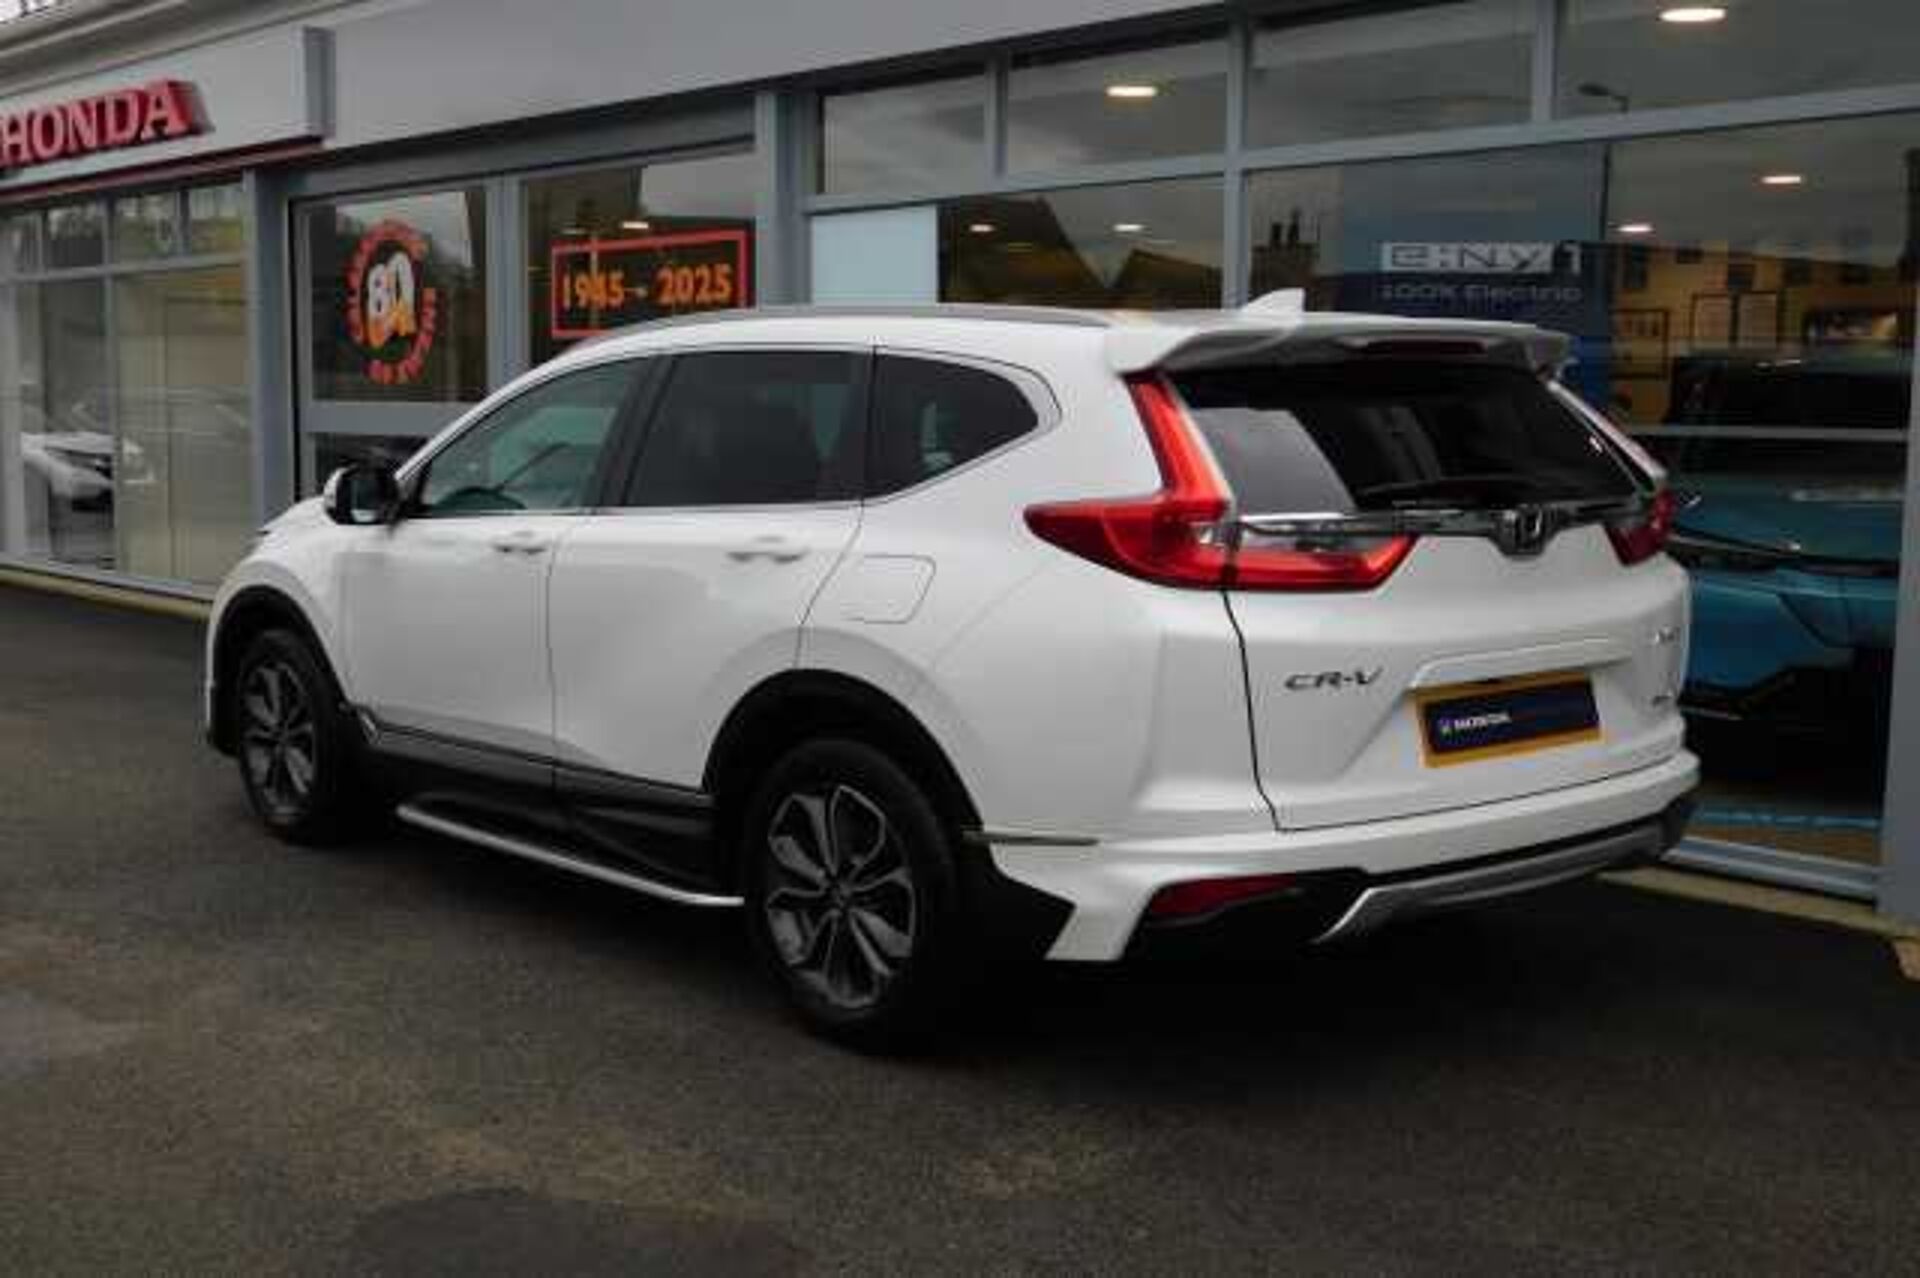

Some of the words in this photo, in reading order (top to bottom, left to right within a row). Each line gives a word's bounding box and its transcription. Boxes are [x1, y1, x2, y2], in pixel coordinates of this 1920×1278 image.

[0, 78, 191, 166] HONDA
[657, 262, 733, 304] 2025
[1284, 666, 1384, 691] CR-V
